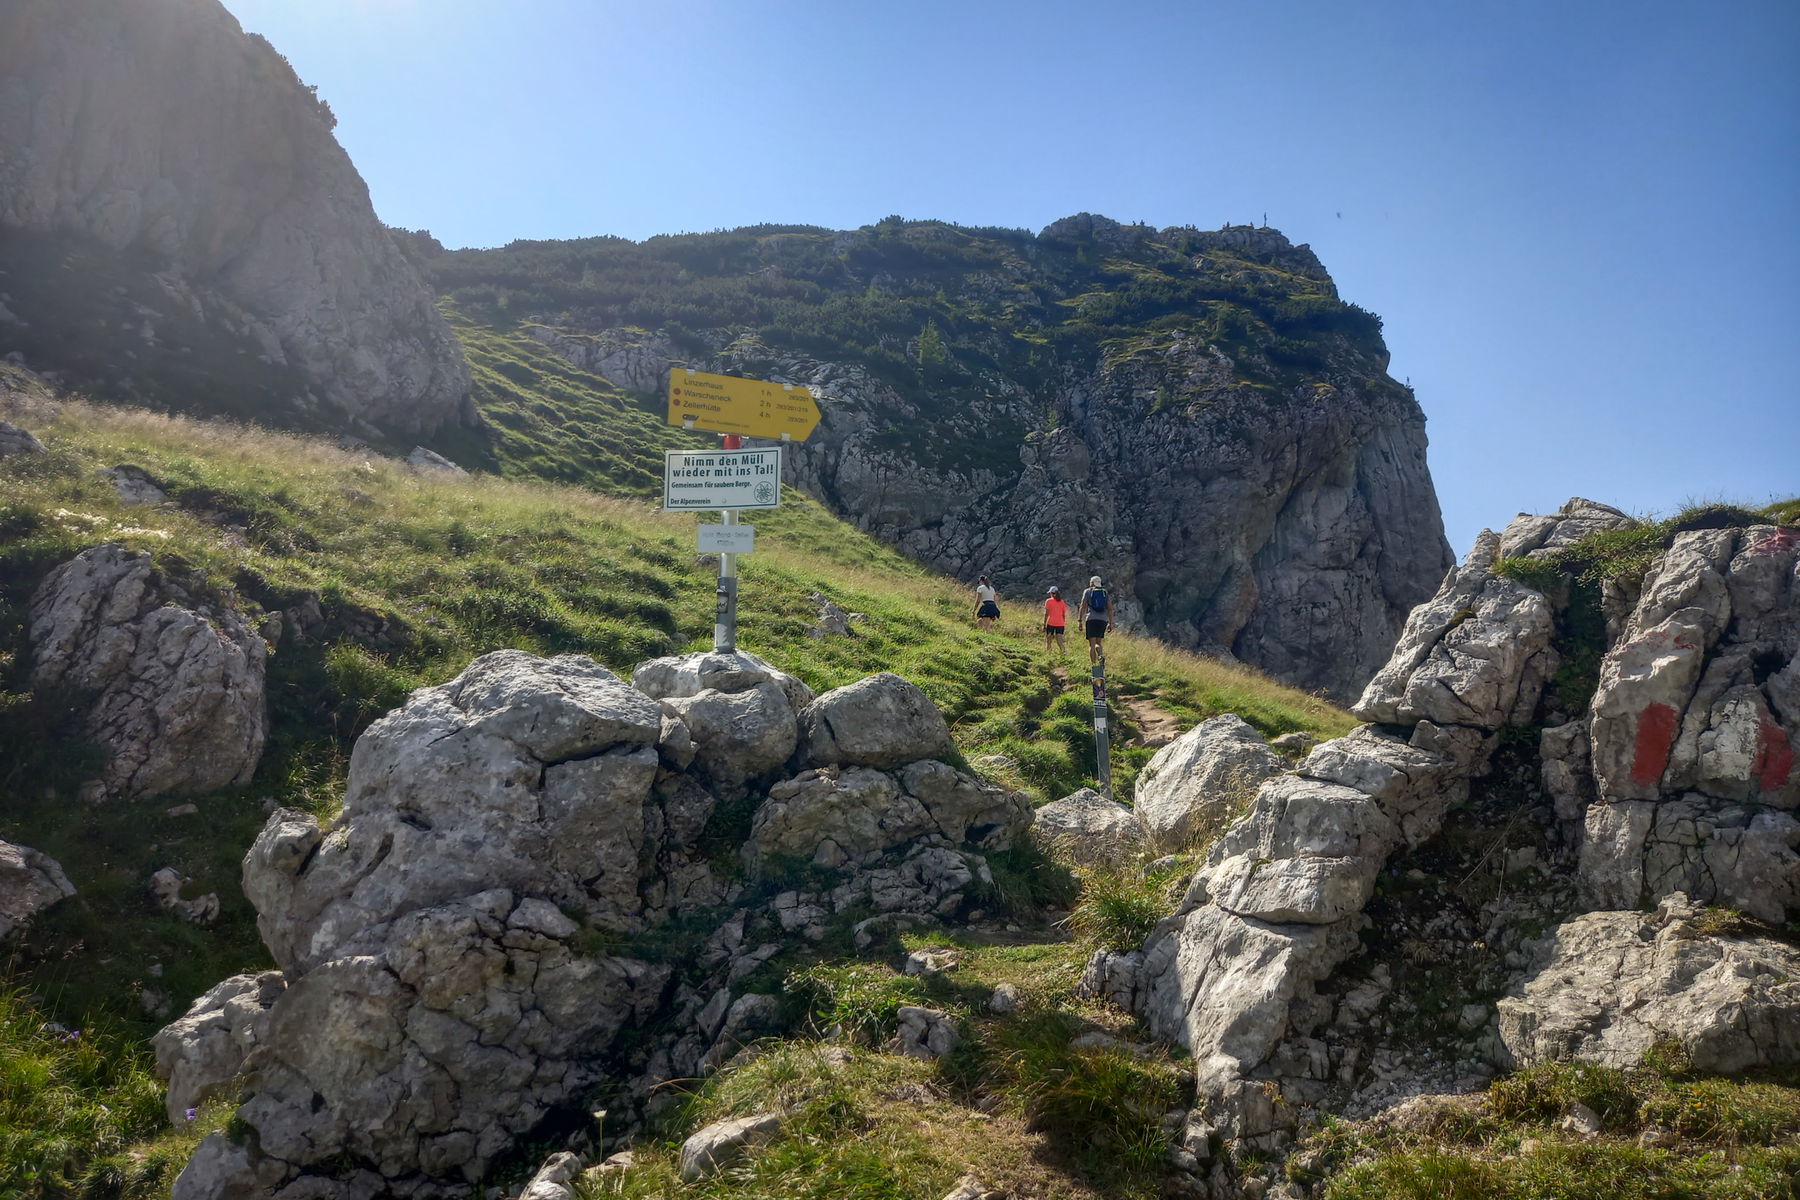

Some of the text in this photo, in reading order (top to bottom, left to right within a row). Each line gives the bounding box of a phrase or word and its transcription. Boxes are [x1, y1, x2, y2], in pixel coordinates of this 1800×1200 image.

[683, 378, 724, 391] Linzerhaus
[683, 389, 732, 402] Warscheneck
[683, 400, 721, 412] Zellerhütte
[684, 454, 764, 467] Nimm den Müll
[672, 464, 774, 477] wieder mit ins Tal!
[671, 481, 703, 489] Gemeinsam
